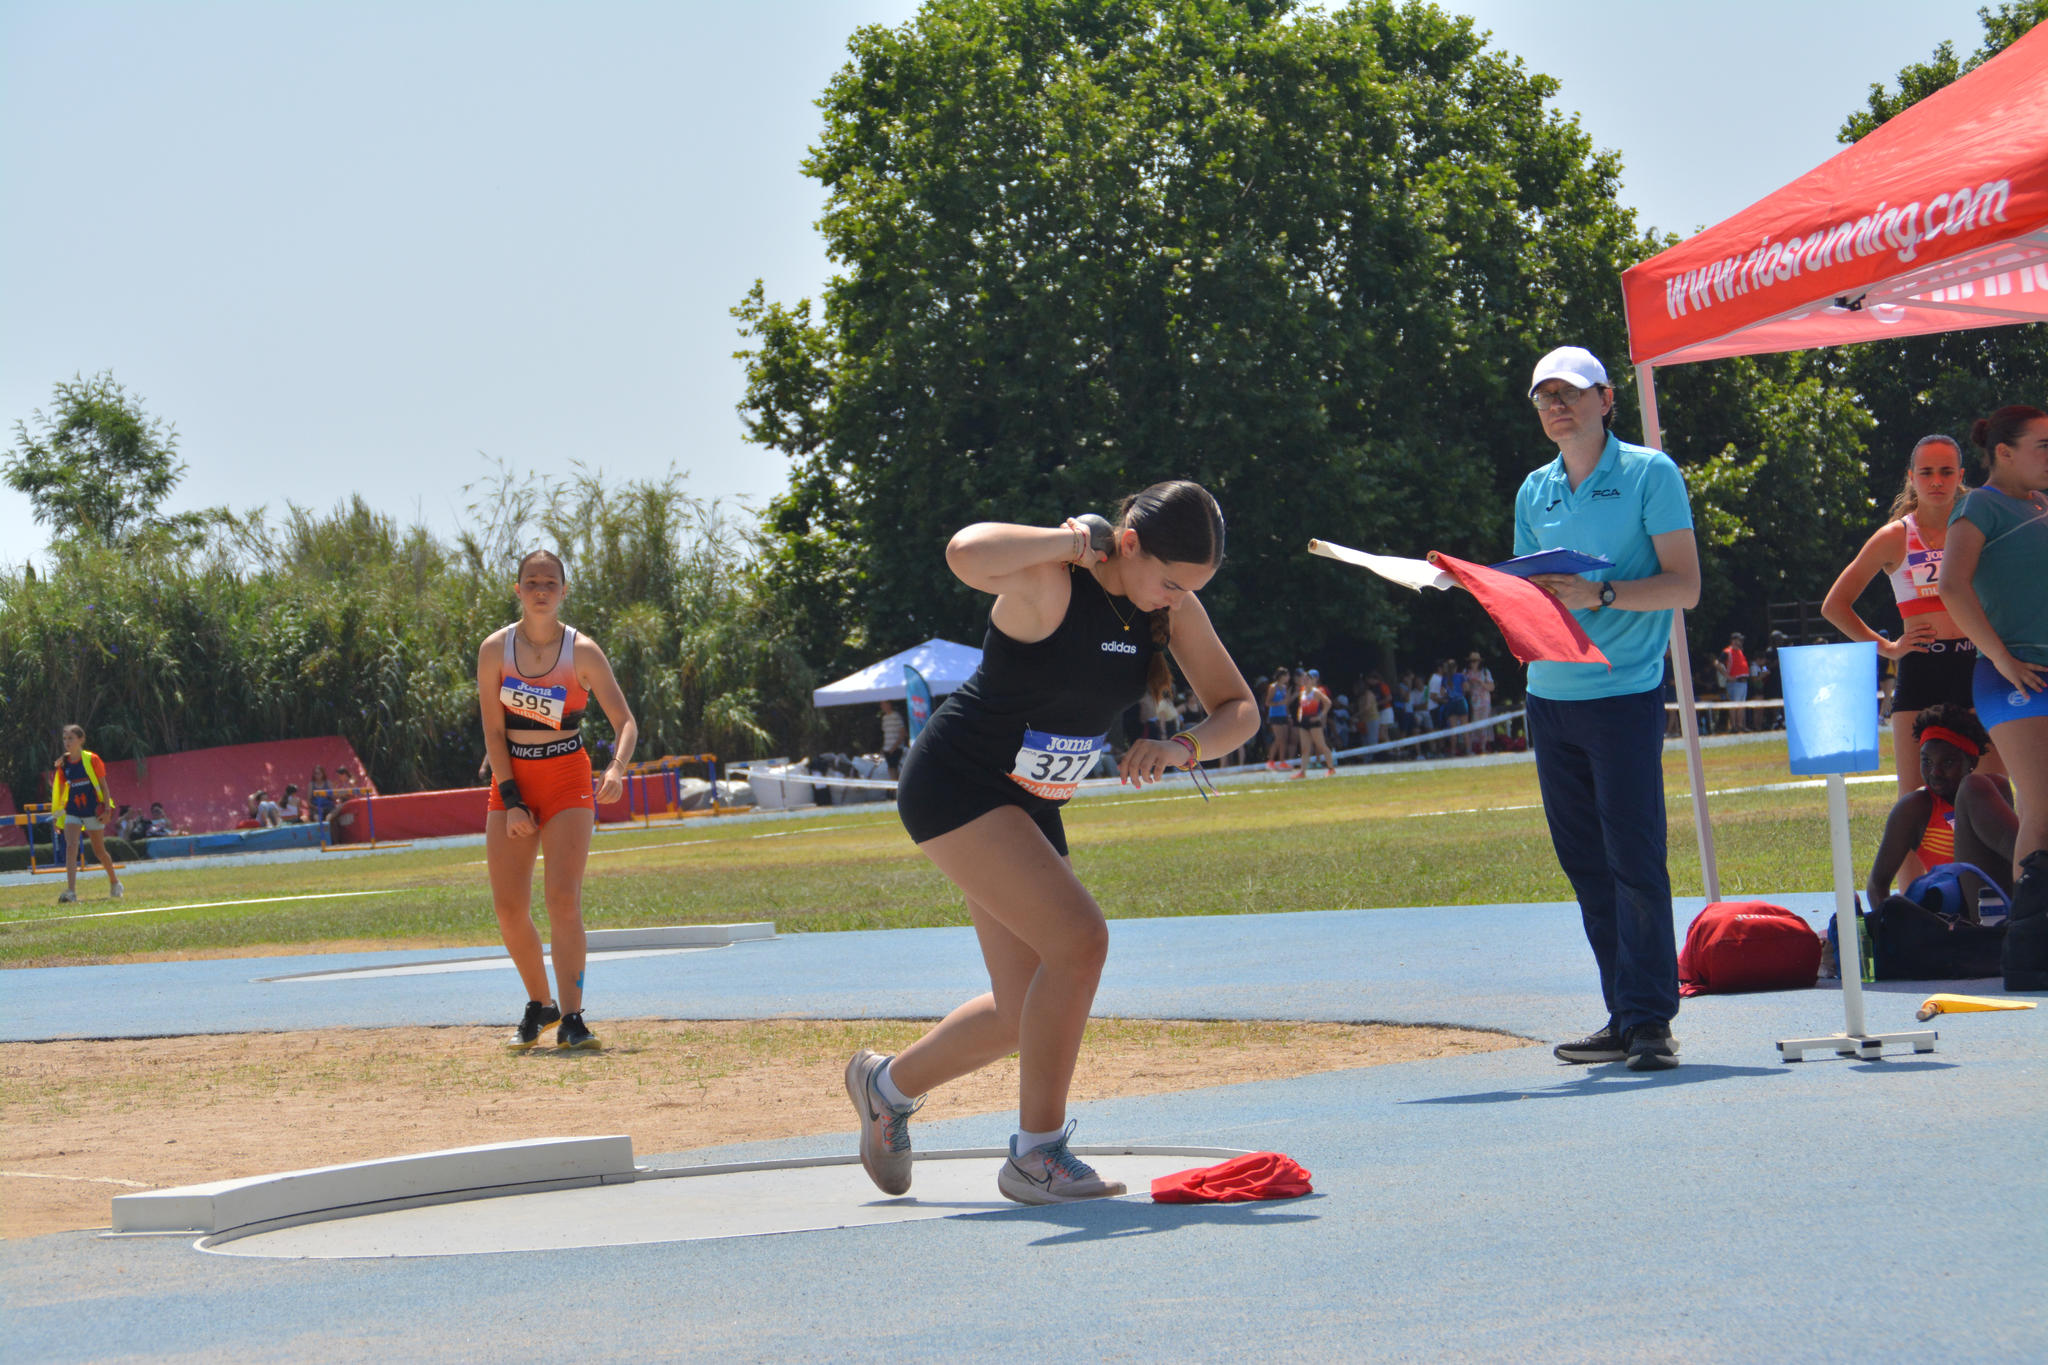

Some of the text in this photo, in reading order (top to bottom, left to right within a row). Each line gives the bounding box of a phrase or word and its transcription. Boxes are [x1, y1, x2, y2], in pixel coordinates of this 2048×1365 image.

[1101, 640, 1137, 654] adidas
[511, 690, 553, 717] 595
[511, 744, 543, 758] NIKE
[546, 739, 577, 756] PRO
[1046, 736, 1093, 752] Joma
[1030, 753, 1091, 781] 327
